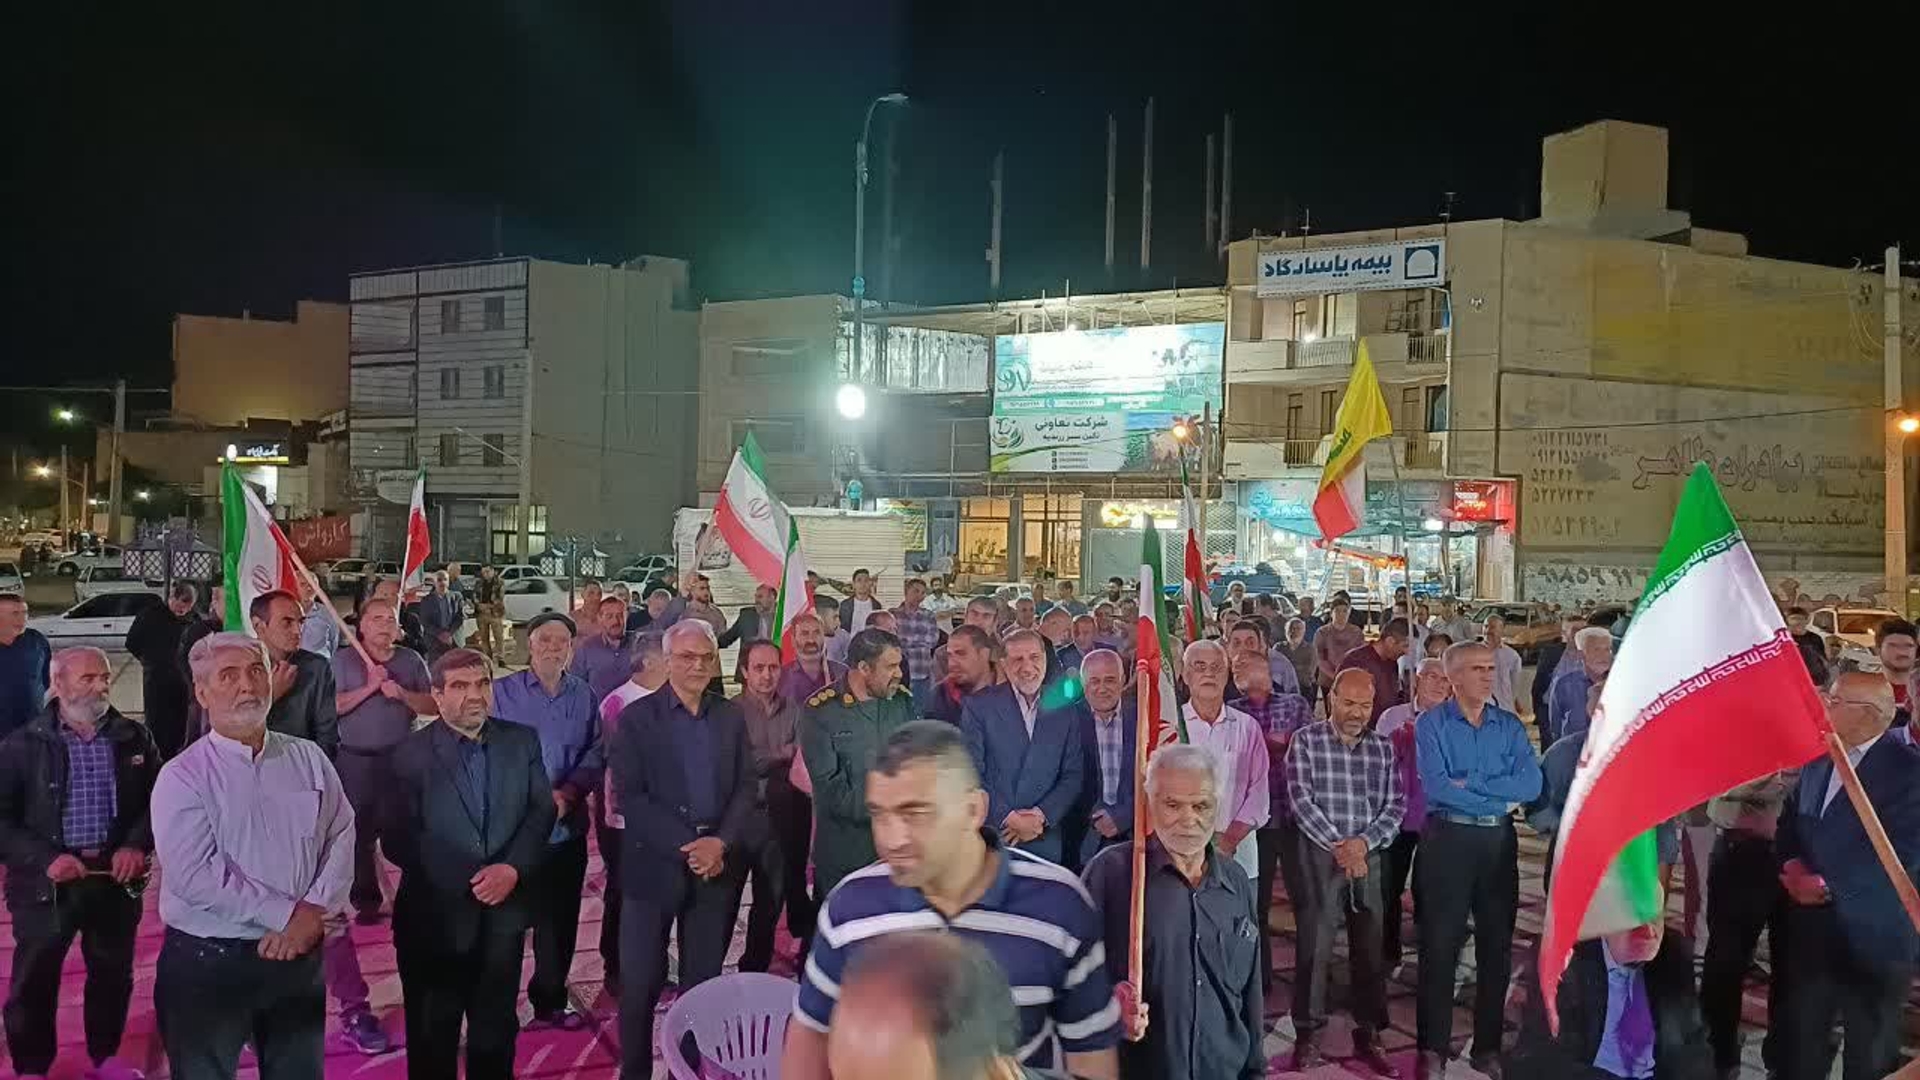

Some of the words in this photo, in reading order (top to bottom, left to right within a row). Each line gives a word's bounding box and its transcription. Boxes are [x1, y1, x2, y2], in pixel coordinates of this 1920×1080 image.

[1264, 255, 1350, 278] پاسارگاد
[1351, 254, 1393, 275] بیمه
[1034, 417, 1071, 432] تعاونی
[1072, 416, 1109, 430] شرکت
[298, 521, 348, 548] کارواش
